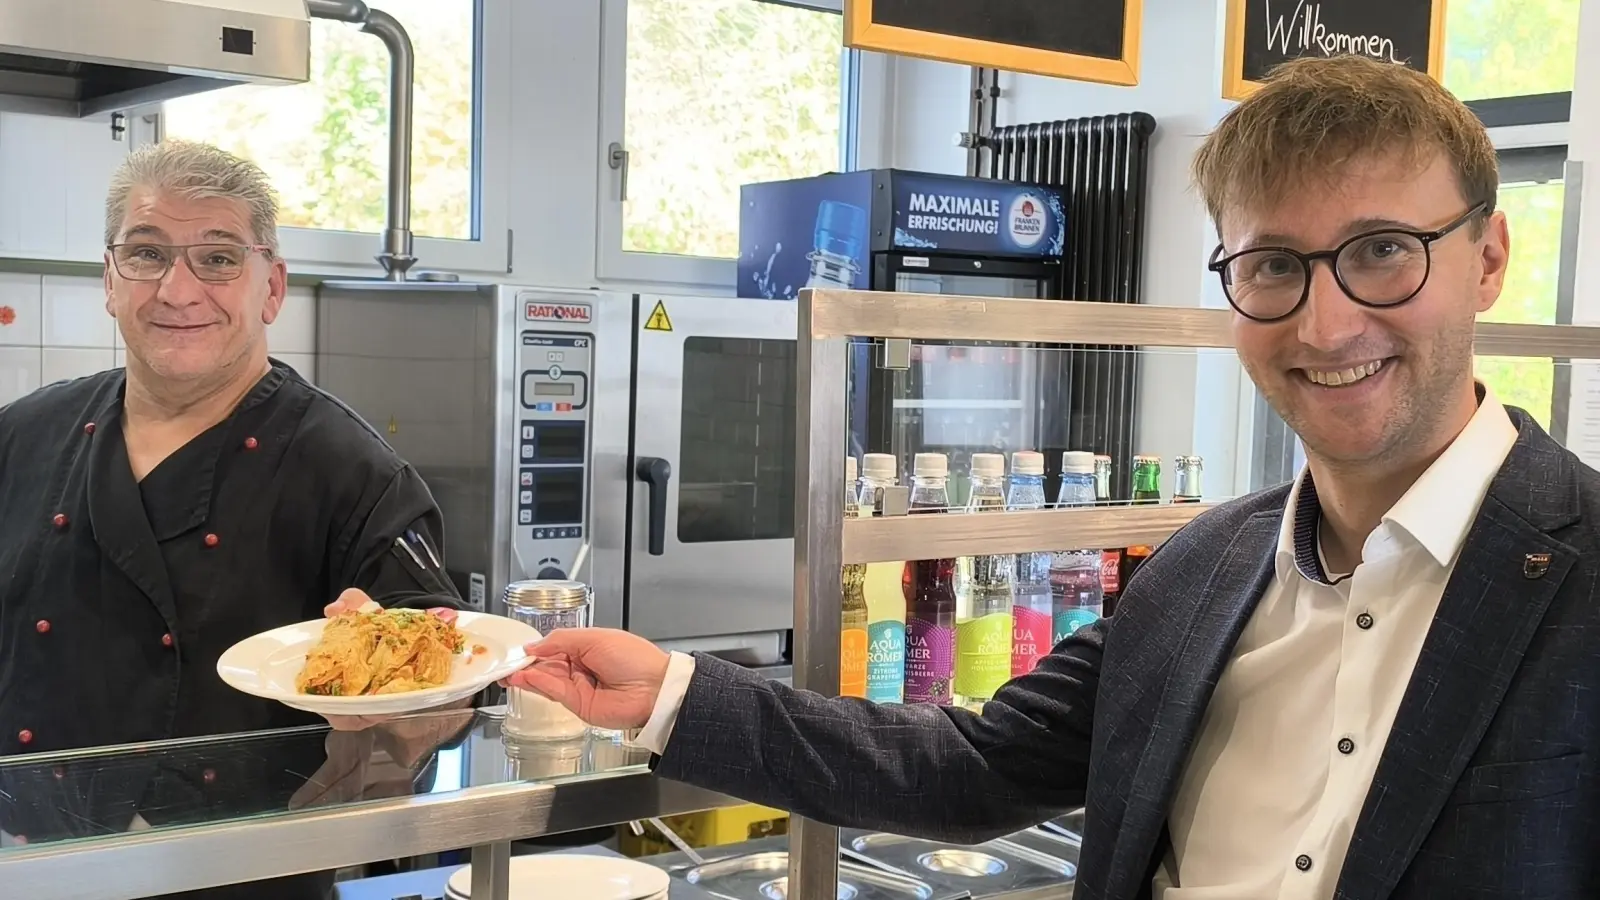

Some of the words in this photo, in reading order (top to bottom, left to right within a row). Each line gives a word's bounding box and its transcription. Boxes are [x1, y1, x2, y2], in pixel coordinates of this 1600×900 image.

[1265, 0, 1405, 65] Willkommen
[908, 193, 1000, 218] MAXIMALE
[908, 214, 999, 235] ERFRISCHUNG!
[1014, 217, 1041, 225] FRANKEN
[1014, 224, 1040, 232] BRUNNEN
[527, 304, 589, 319] RATIONAL
[981, 631, 1009, 643] AQU
[869, 640, 902, 652] AQUA
